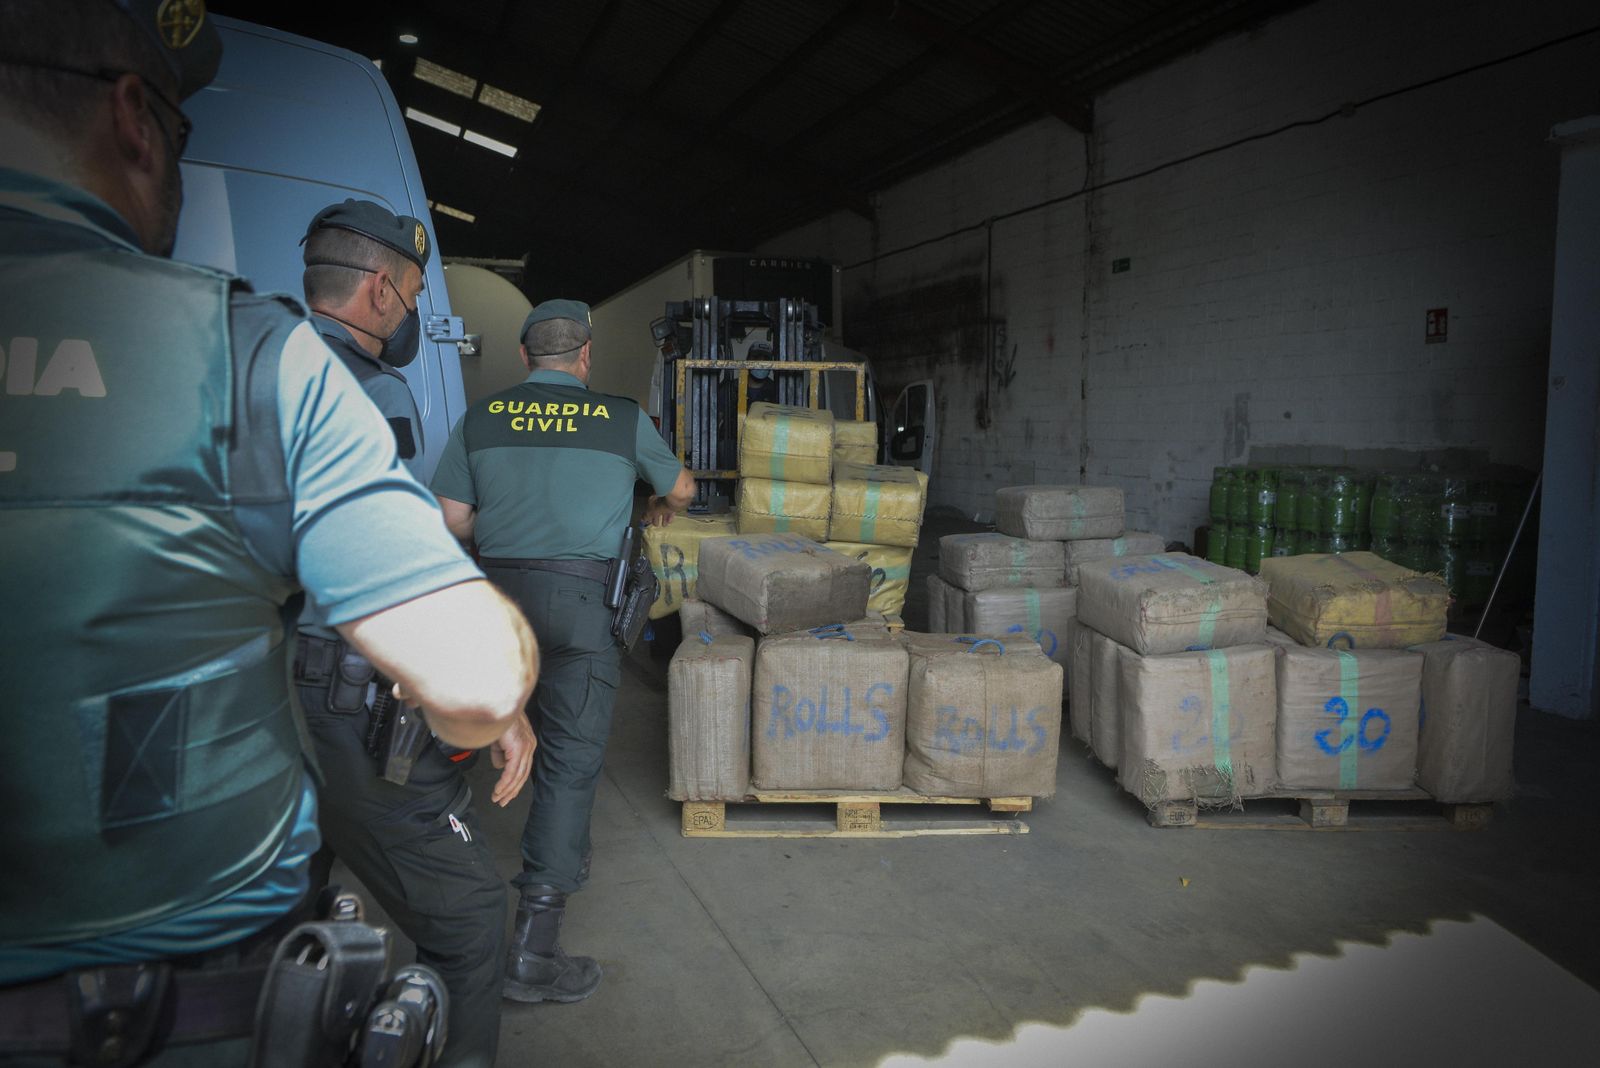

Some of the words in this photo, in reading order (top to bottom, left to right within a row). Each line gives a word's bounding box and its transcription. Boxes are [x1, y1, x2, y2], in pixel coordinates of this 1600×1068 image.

[0, 336, 107, 398] IA
[488, 400, 610, 419] GUARDIA
[511, 416, 578, 433] CIVIL
